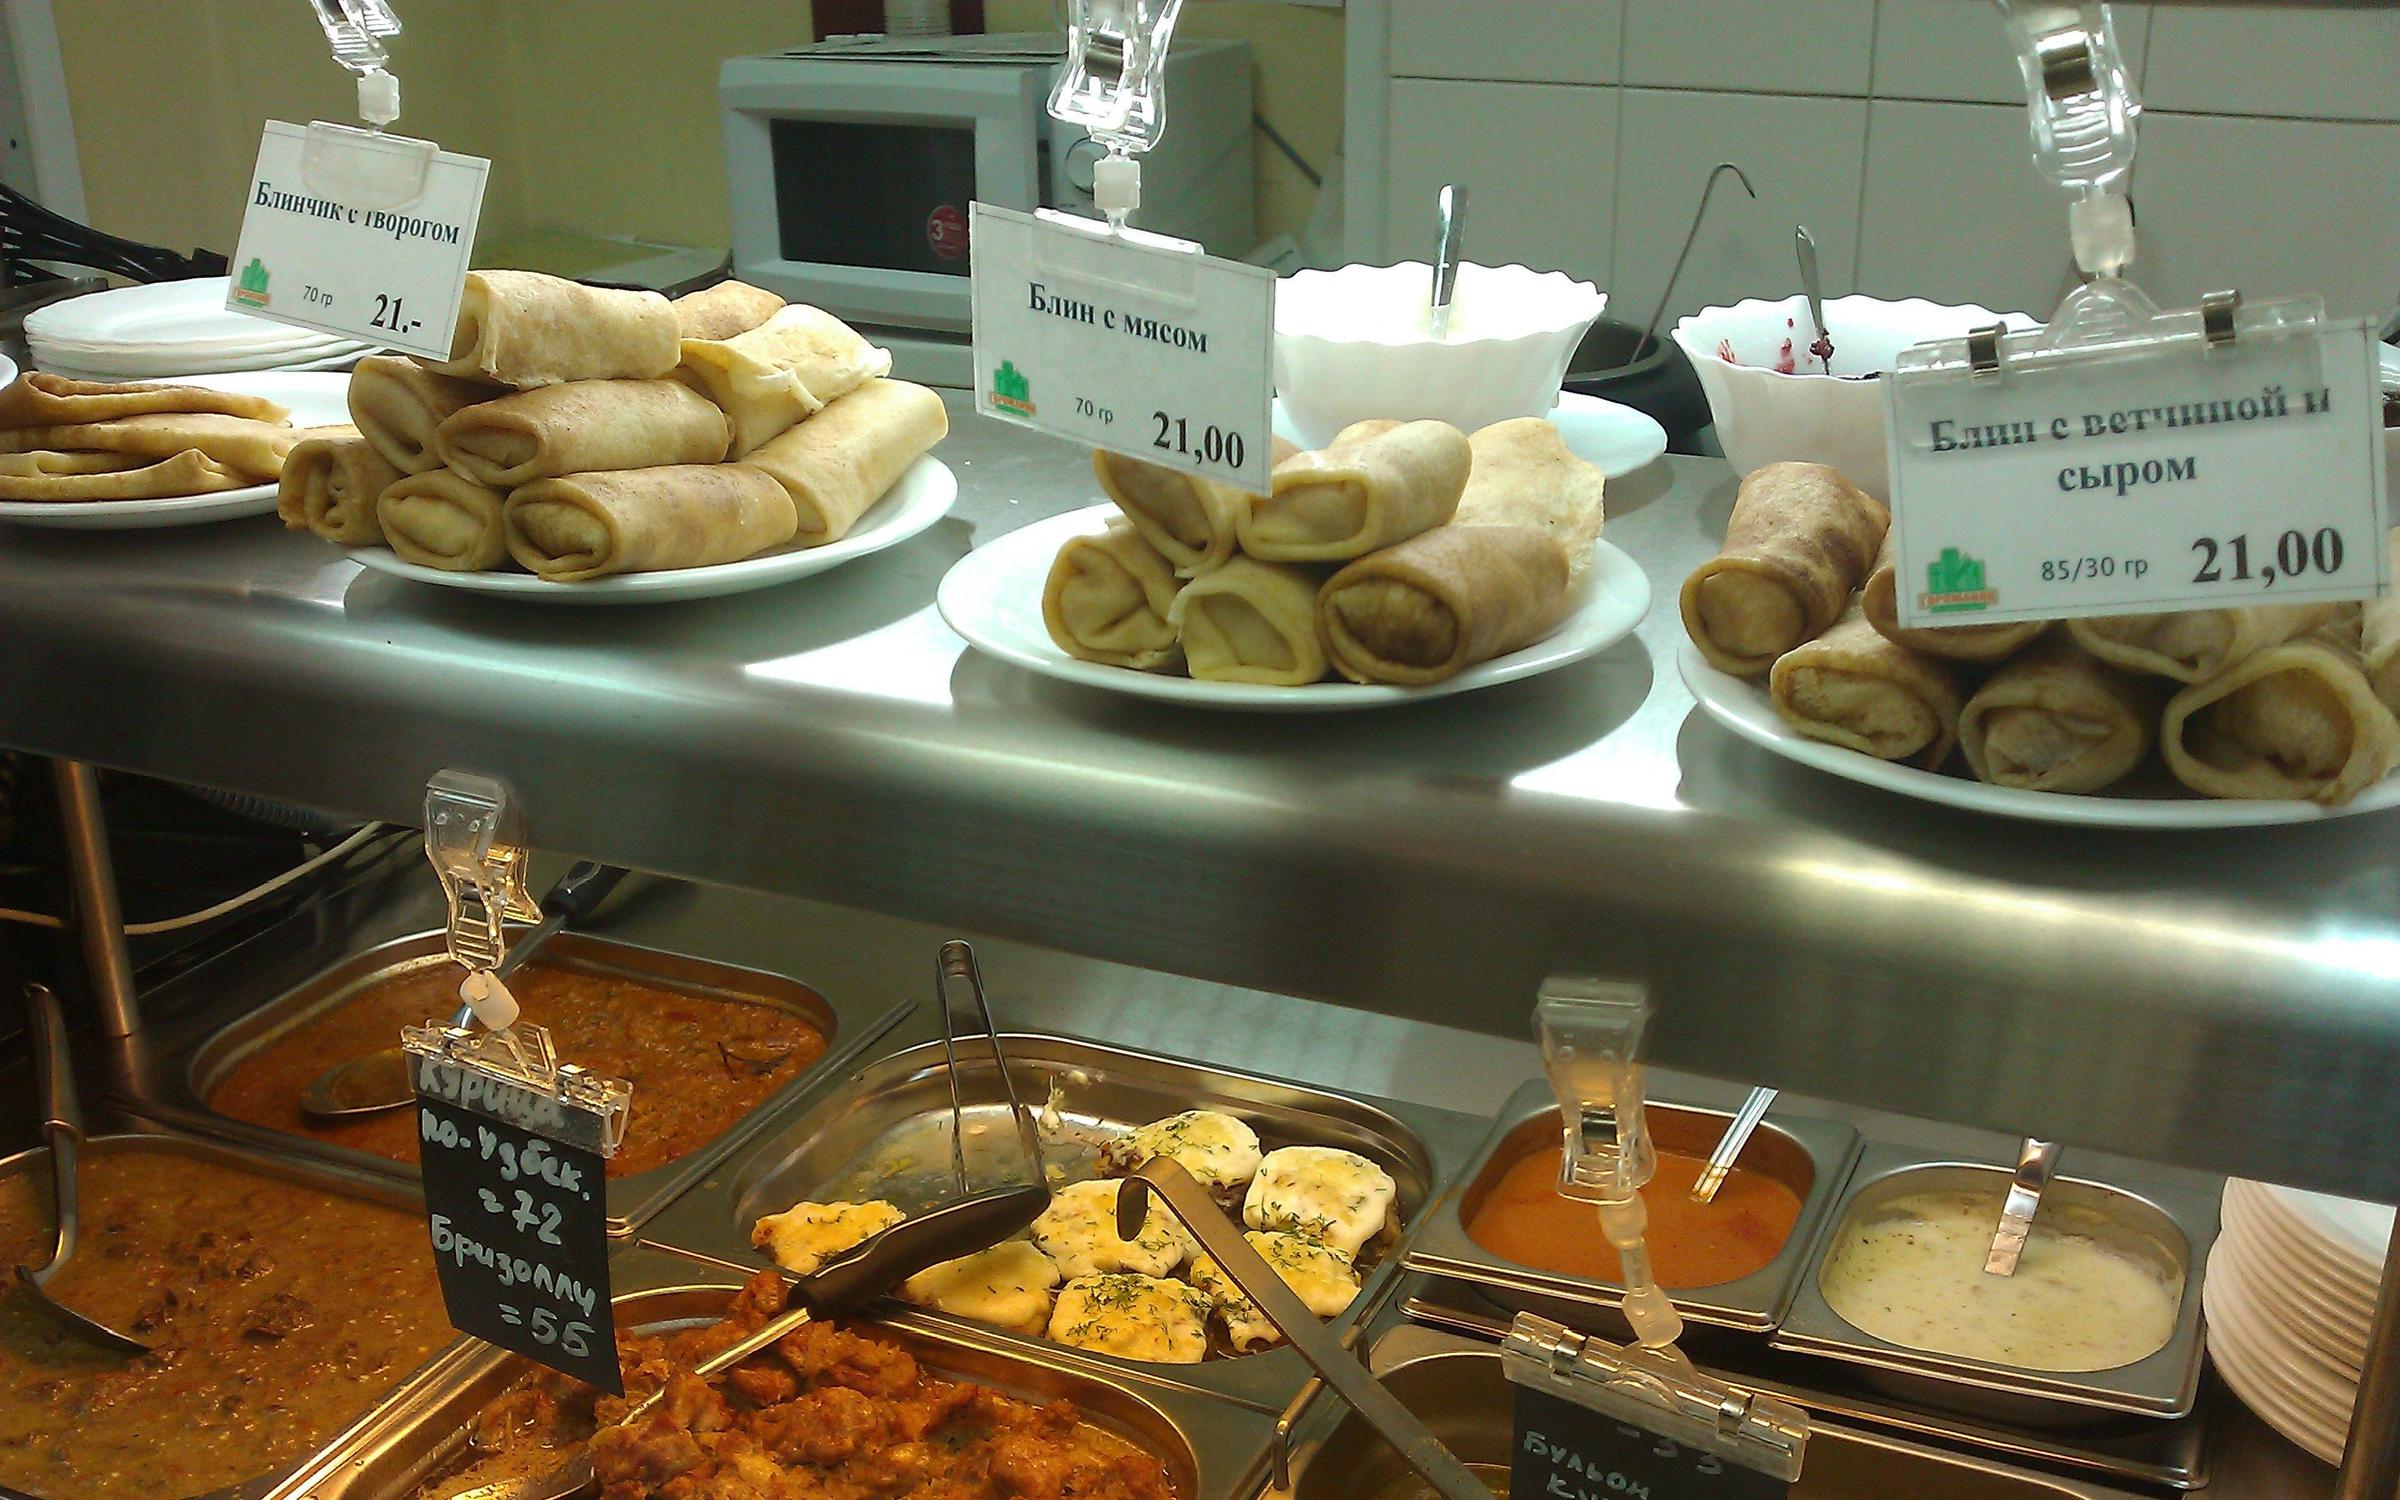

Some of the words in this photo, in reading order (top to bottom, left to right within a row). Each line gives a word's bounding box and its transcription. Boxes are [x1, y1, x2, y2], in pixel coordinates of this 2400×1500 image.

[254, 181, 344, 222] Блинчик
[346, 208, 358, 224] с
[303, 285, 318, 302] 70
[320, 291, 333, 307] гр
[1028, 282, 1095, 325] Блин
[1103, 309, 1115, 329] с
[1123, 314, 1208, 353] мясом
[1075, 398, 1094, 416] 70
[1098, 407, 1114, 425] гр
[1930, 419, 2036, 452] Блин
[2051, 417, 2070, 440] с
[2083, 386, 2289, 437] ветчиной
[2302, 388, 2331, 414] и
[1152, 411, 1244, 469] 21,00
[2058, 456, 2197, 497] сыром
[2040, 556, 2115, 582] 85/30
[2124, 557, 2149, 578] гр
[2191, 526, 2345, 589] 21,00
